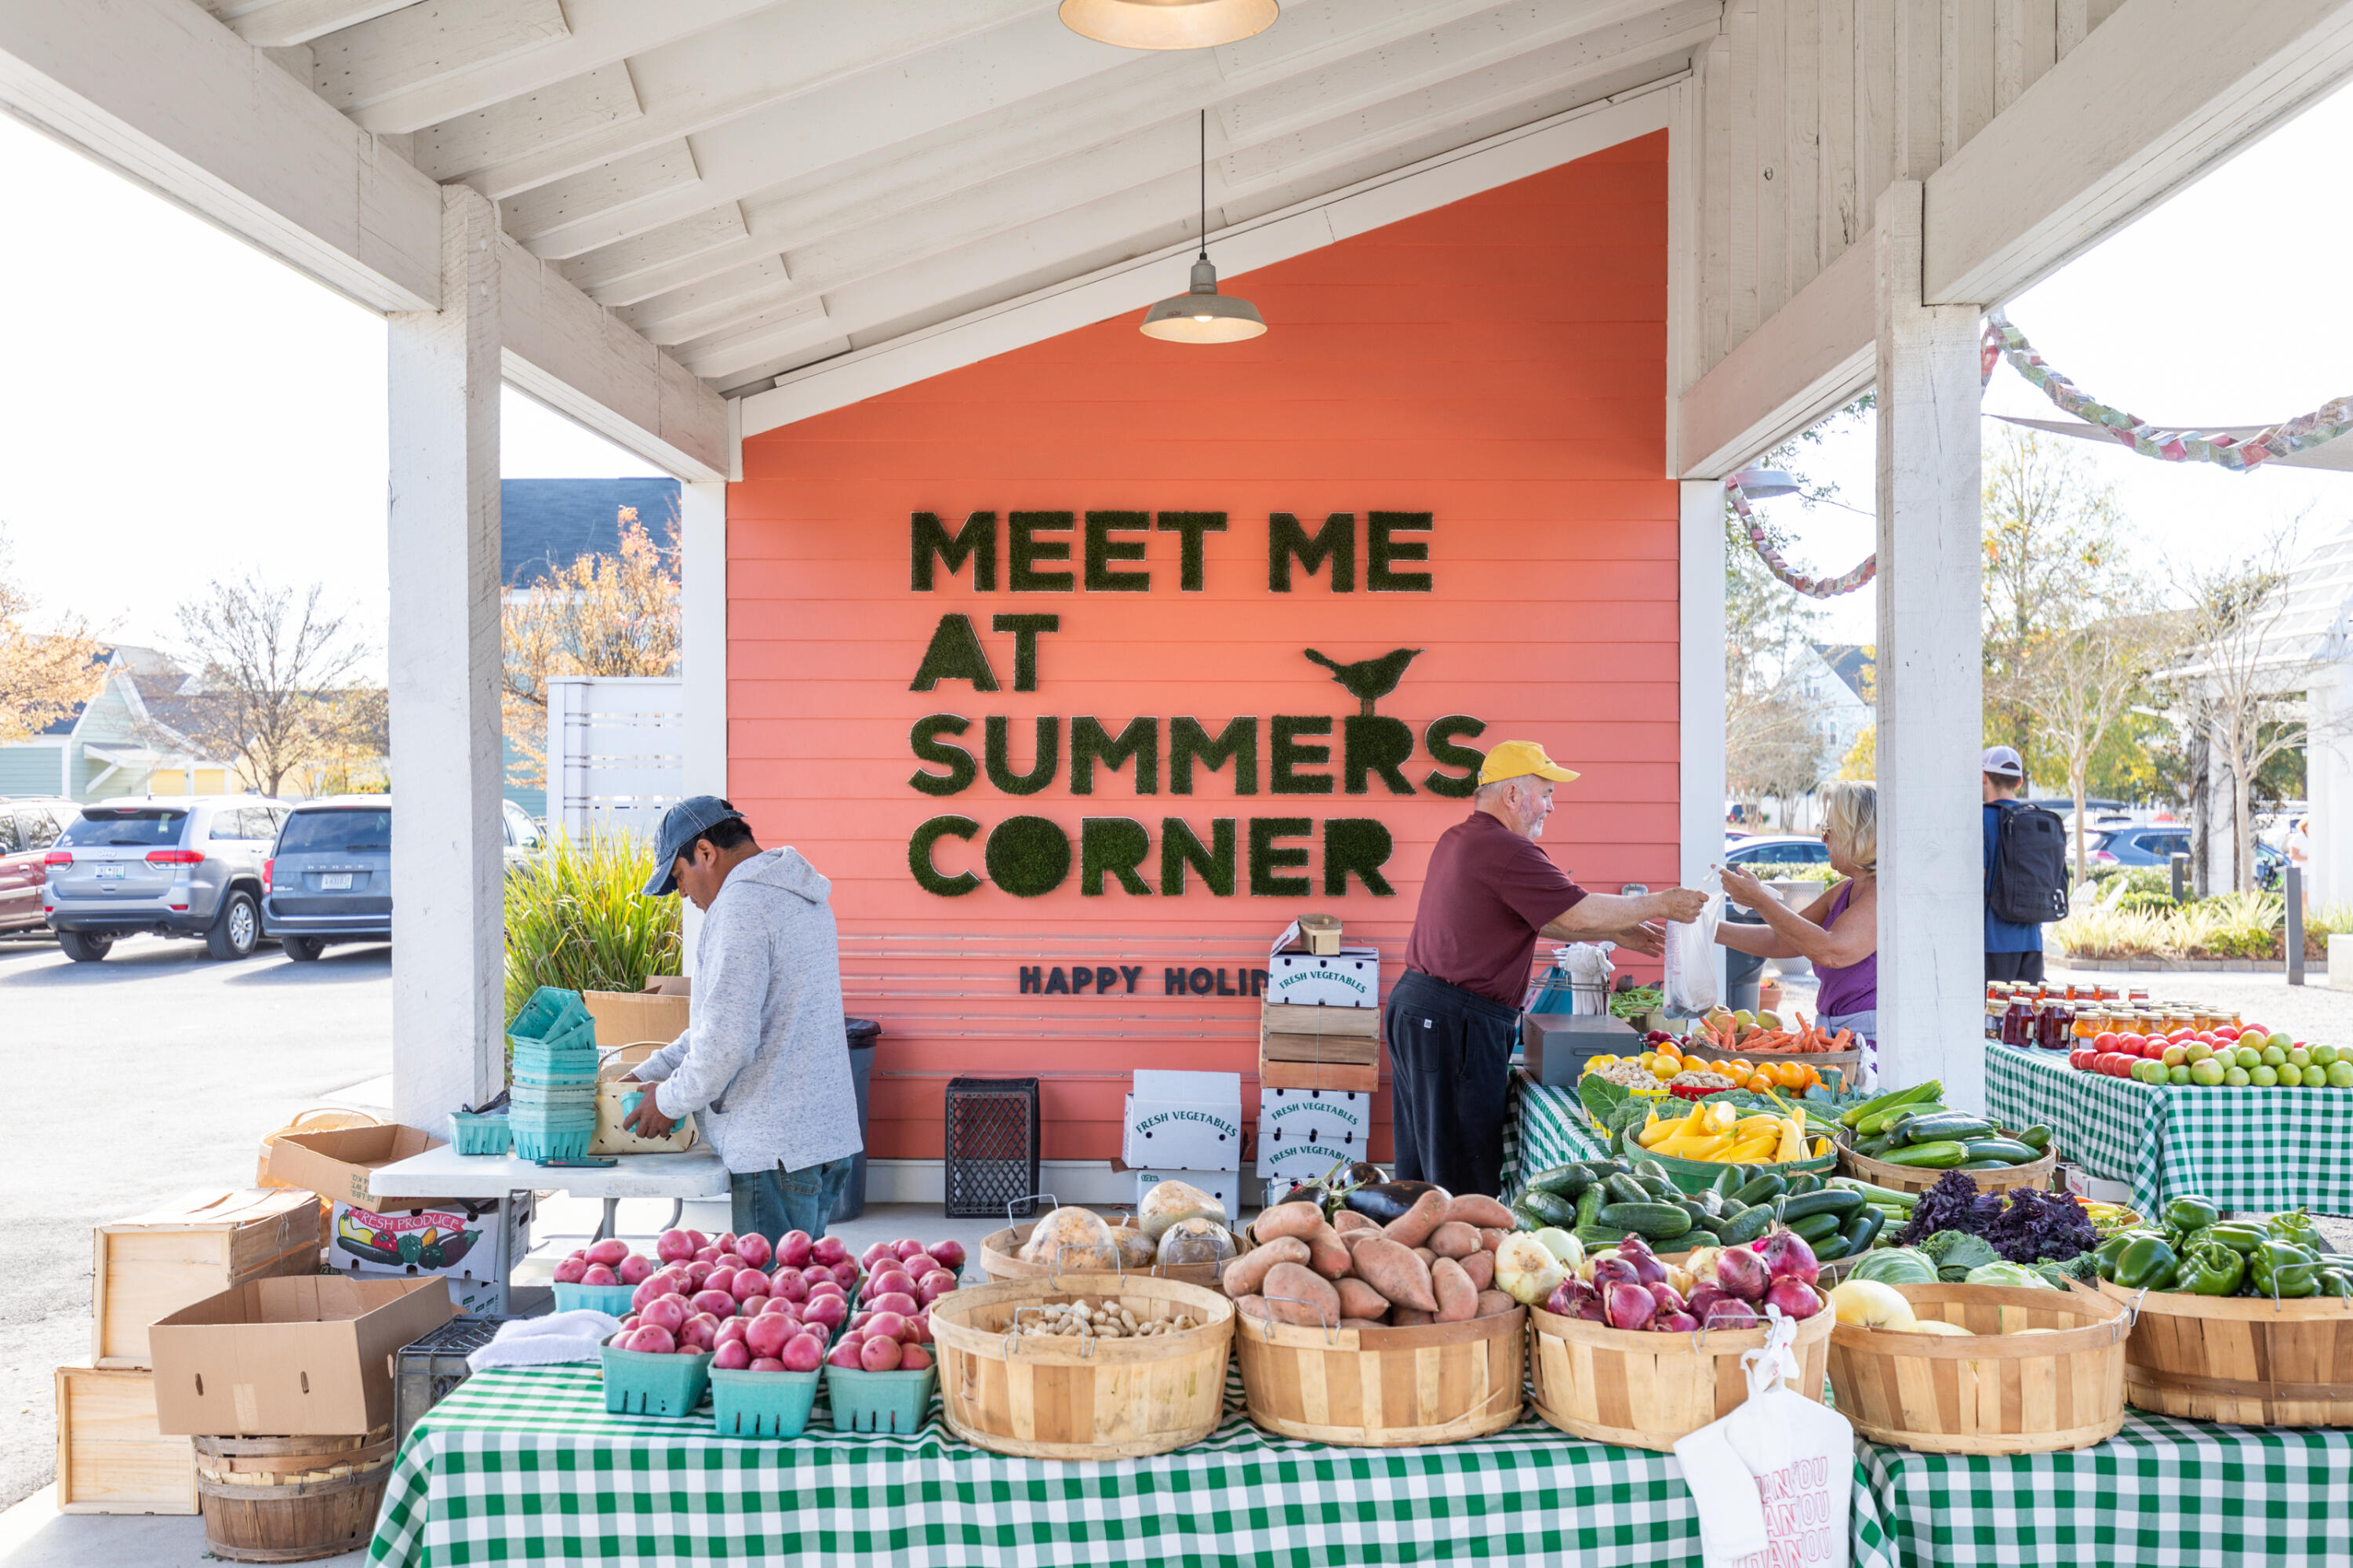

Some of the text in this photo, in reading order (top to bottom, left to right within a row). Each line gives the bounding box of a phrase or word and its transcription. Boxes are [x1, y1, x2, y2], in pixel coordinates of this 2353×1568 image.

[911, 510, 1434, 593] MEET ME
[909, 613, 1060, 693] AT
[907, 712, 1488, 798] SUMMERS
[908, 814, 1398, 898] CORNER
[1020, 966, 1269, 996] HAPPY HOLID
[1278, 970, 1366, 994] FRESH VEGETABLES
[1135, 1111, 1238, 1137] FRESH VEGETABLES
[1271, 1102, 1359, 1126] FRESH VEGETABLES
[1268, 1147, 1297, 1165] FRESH
[355, 1210, 460, 1231] FRESH PRODUCE
[1793, 1456, 1828, 1490] OU
[1796, 1490, 1831, 1526] OU
[1802, 1526, 1833, 1563] OU
